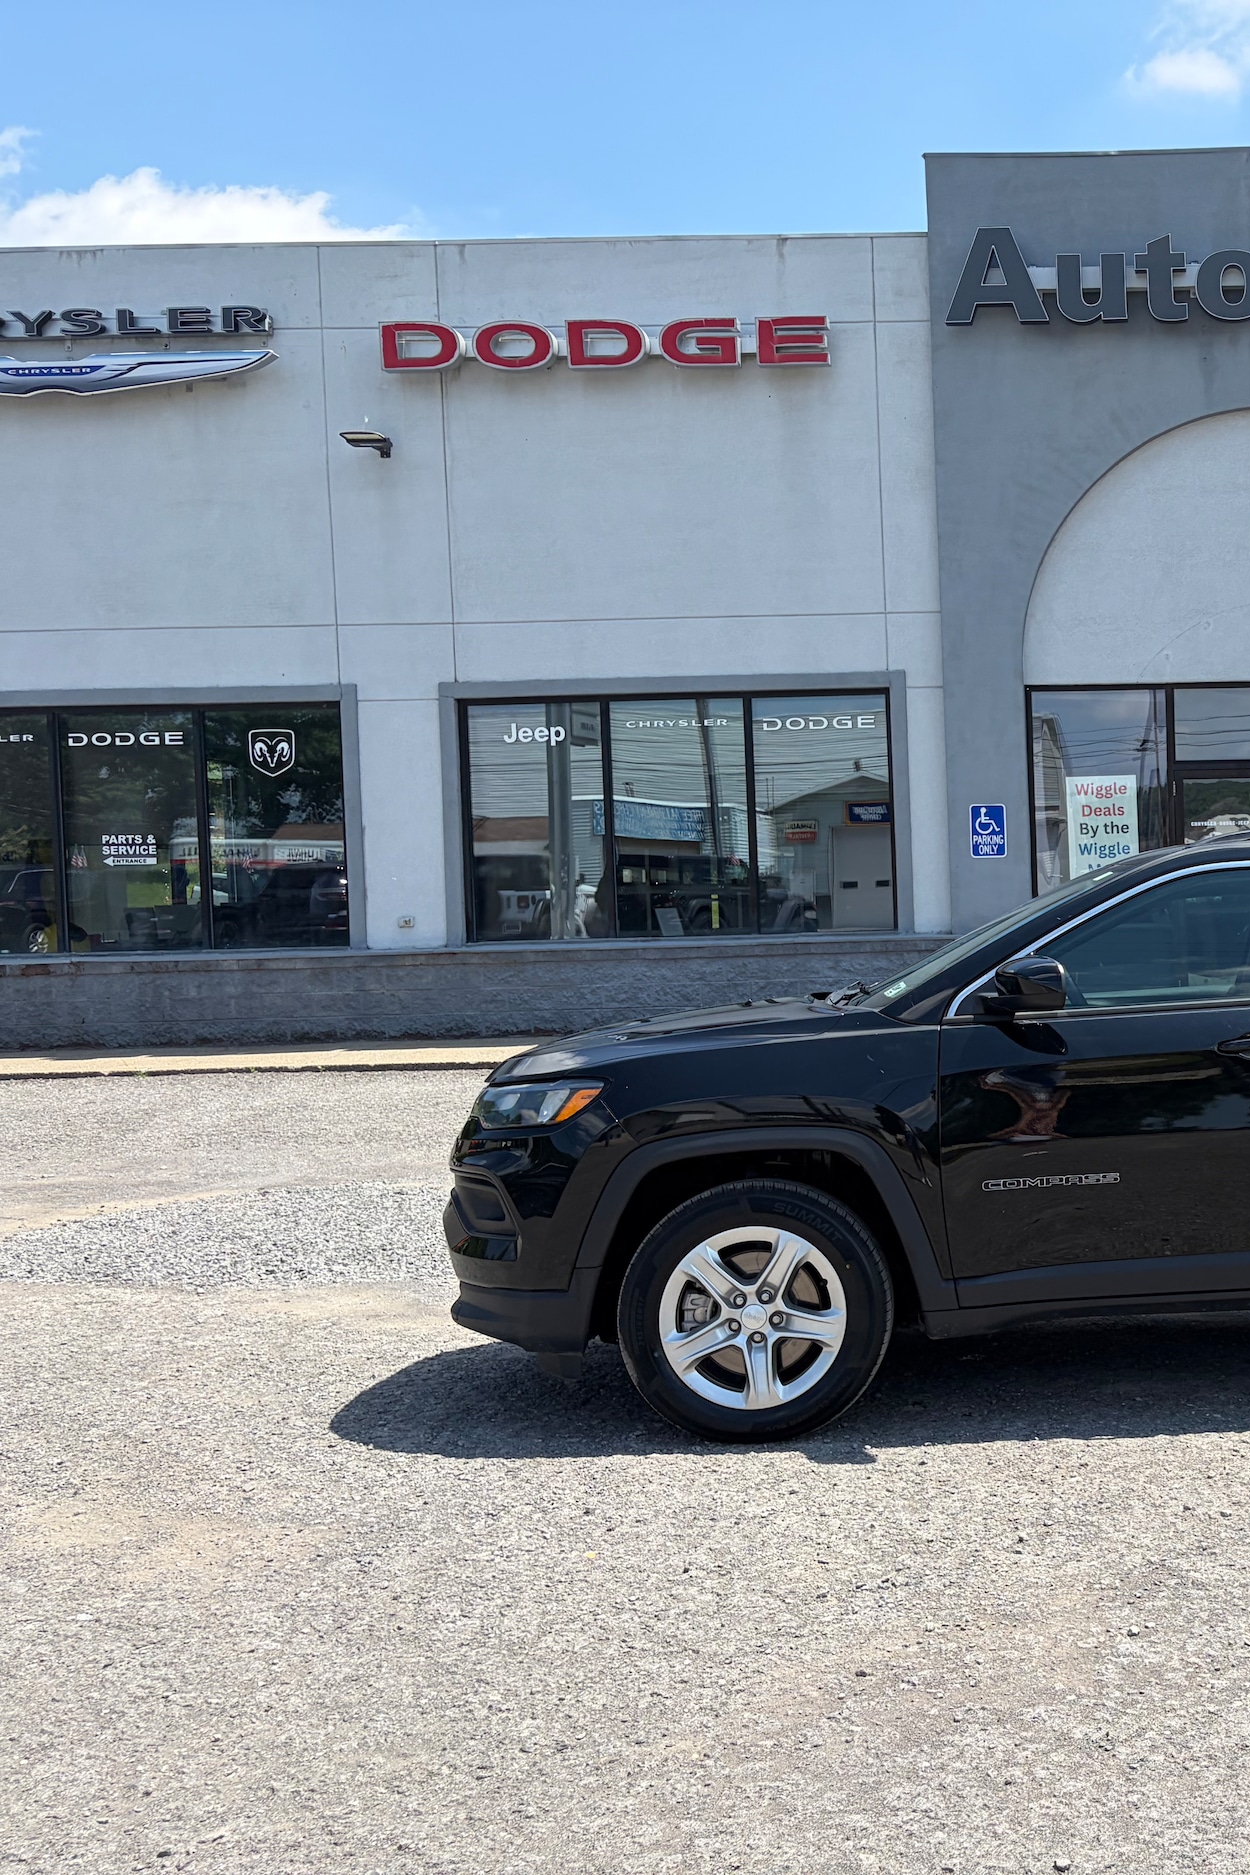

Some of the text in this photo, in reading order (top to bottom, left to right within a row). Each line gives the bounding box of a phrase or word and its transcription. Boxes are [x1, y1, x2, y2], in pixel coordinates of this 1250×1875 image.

[0, 306, 269, 337] YSLER
[378, 315, 832, 373] DODGE
[7, 367, 92, 376] CHRYSLER
[626, 718, 729, 728] CHRYSLER
[762, 715, 876, 731] DODGE
[67, 732, 184, 747] DODGE
[503, 723, 566, 746] Jeep
[1074, 782, 1128, 799] Wiggle
[1081, 804, 1125, 817] Deals
[1079, 821, 1130, 838] By the
[101, 834, 156, 844] PARTS &
[973, 835, 1004, 845] PARKING
[101, 845, 157, 855] SERVICE
[978, 845, 999, 855] ONLY
[1078, 842, 1131, 859] Wiggle
[981, 1172, 1121, 1192] COMPASS
[772, 1202, 844, 1242] SUMMIT
